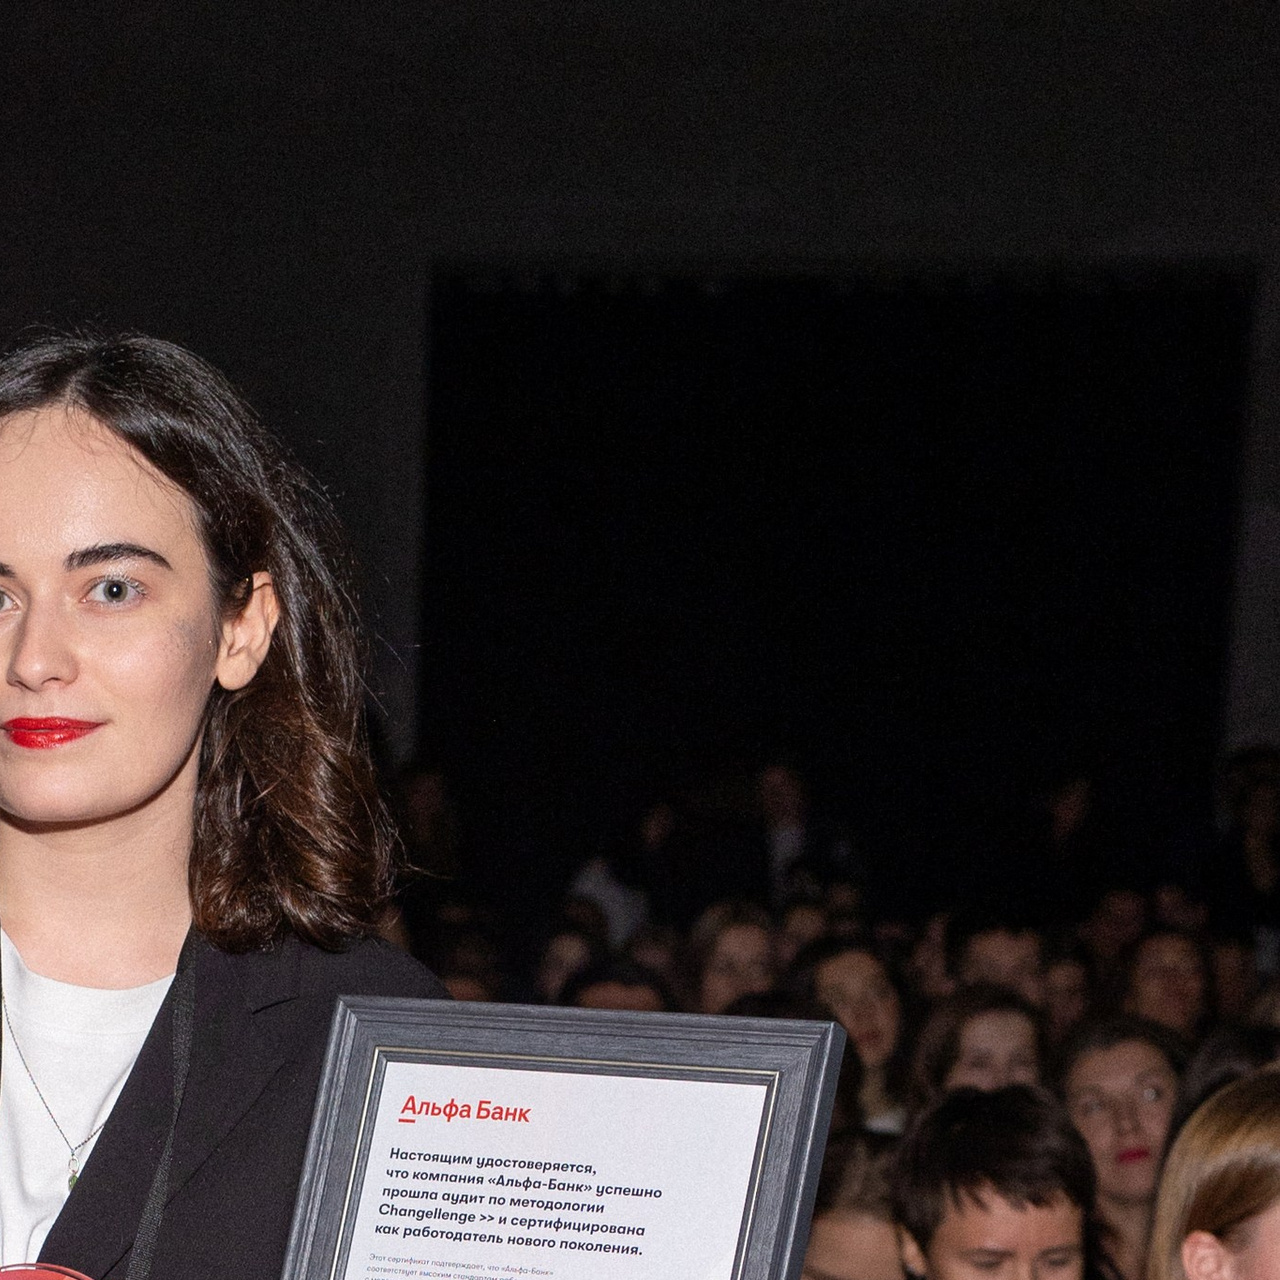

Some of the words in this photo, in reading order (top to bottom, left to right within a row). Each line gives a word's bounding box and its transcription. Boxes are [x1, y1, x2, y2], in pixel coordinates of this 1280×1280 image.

[399, 1095, 471, 1123] Альфа
[475, 1100, 531, 1122] Банк
[390, 1147, 473, 1165] Настоящим
[476, 1157, 596, 1176] удостоверяется,
[386, 1169, 409, 1179] что
[412, 1171, 484, 1185] компания
[488, 1175, 592, 1192] «Альфа-Банк»
[596, 1185, 662, 1198] успешно
[382, 1188, 438, 1200] прошла
[442, 1192, 485, 1205] аудит
[488, 1196, 506, 1206] по
[509, 1198, 605, 1213] методологии
[379, 1203, 476, 1225] Changellenge
[498, 1216, 507, 1225] и
[511, 1217, 645, 1236] сертифицирована
[375, 1225, 400, 1235] как
[403, 1226, 503, 1244] работодатель
[507, 1236, 556, 1248] нового
[559, 1240, 642, 1255] поколения.
